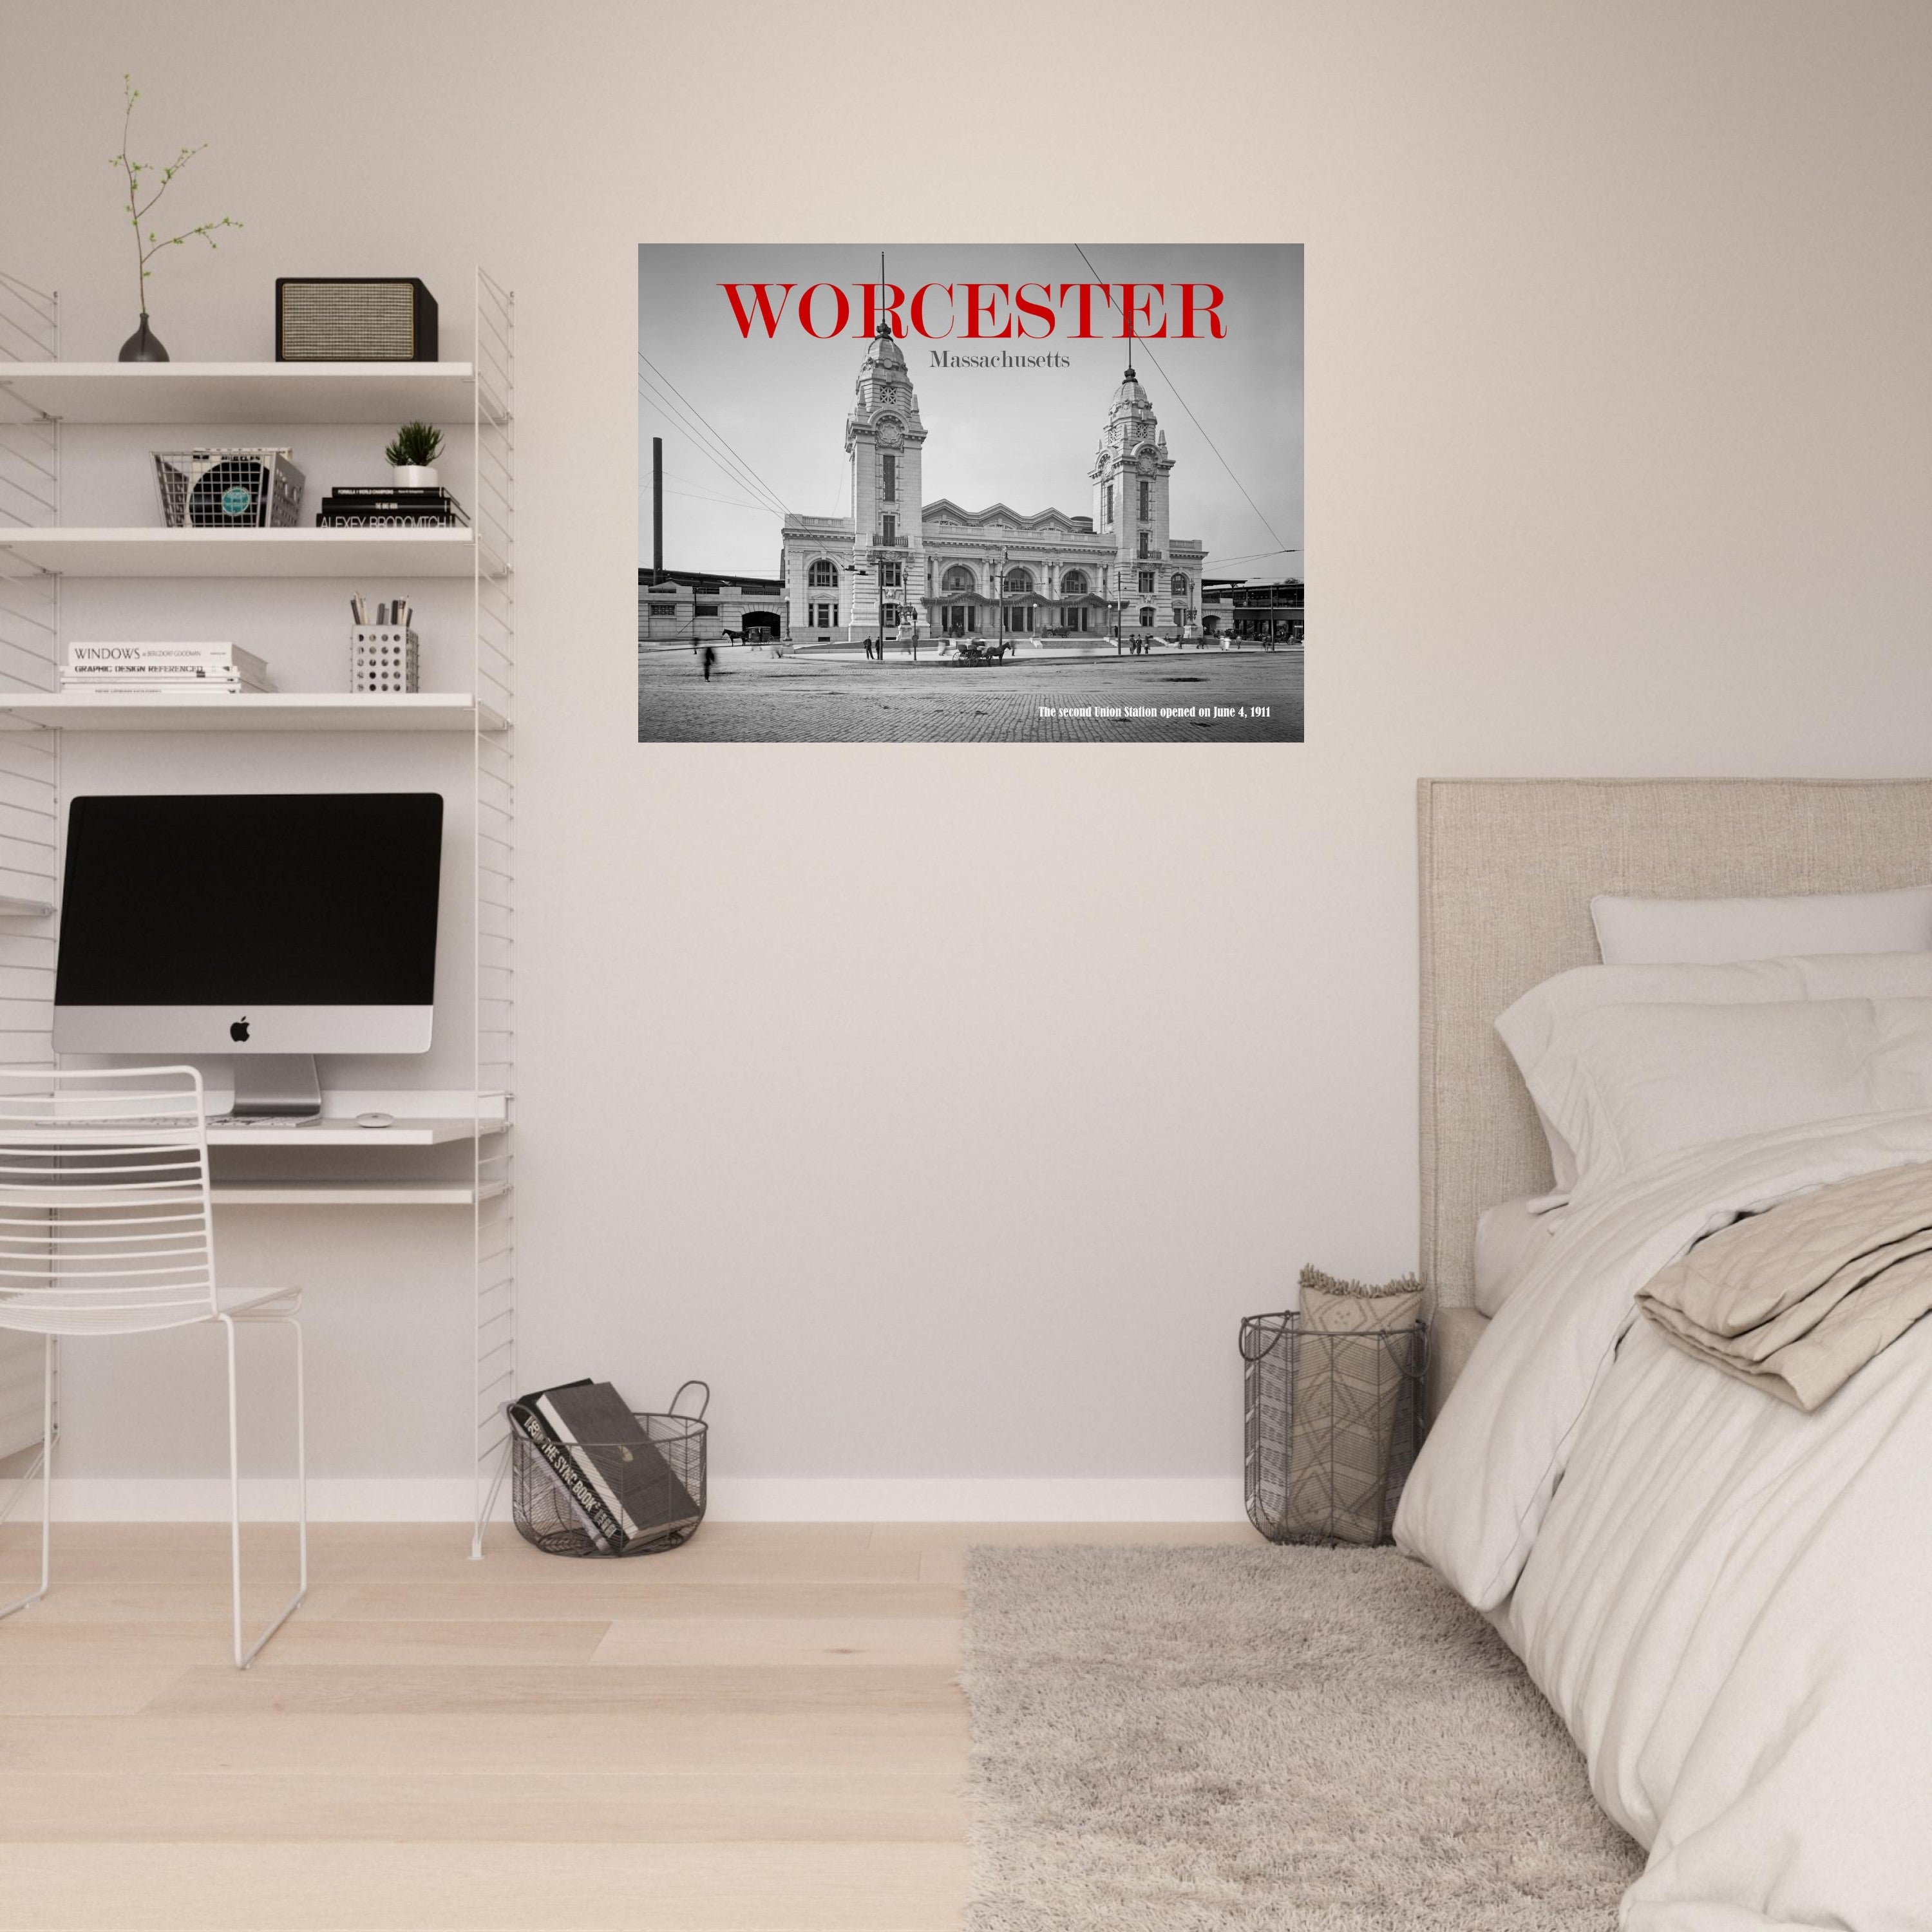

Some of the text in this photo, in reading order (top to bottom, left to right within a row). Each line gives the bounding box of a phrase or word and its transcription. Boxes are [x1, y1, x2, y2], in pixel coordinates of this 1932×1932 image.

[716, 283, 1227, 339] WORCESTER
[929, 350, 1070, 368] Massachusetts
[75, 648, 140, 659] WINDOWS
[1038, 706, 1271, 719] The second Union Station opened on June 4, 1911
